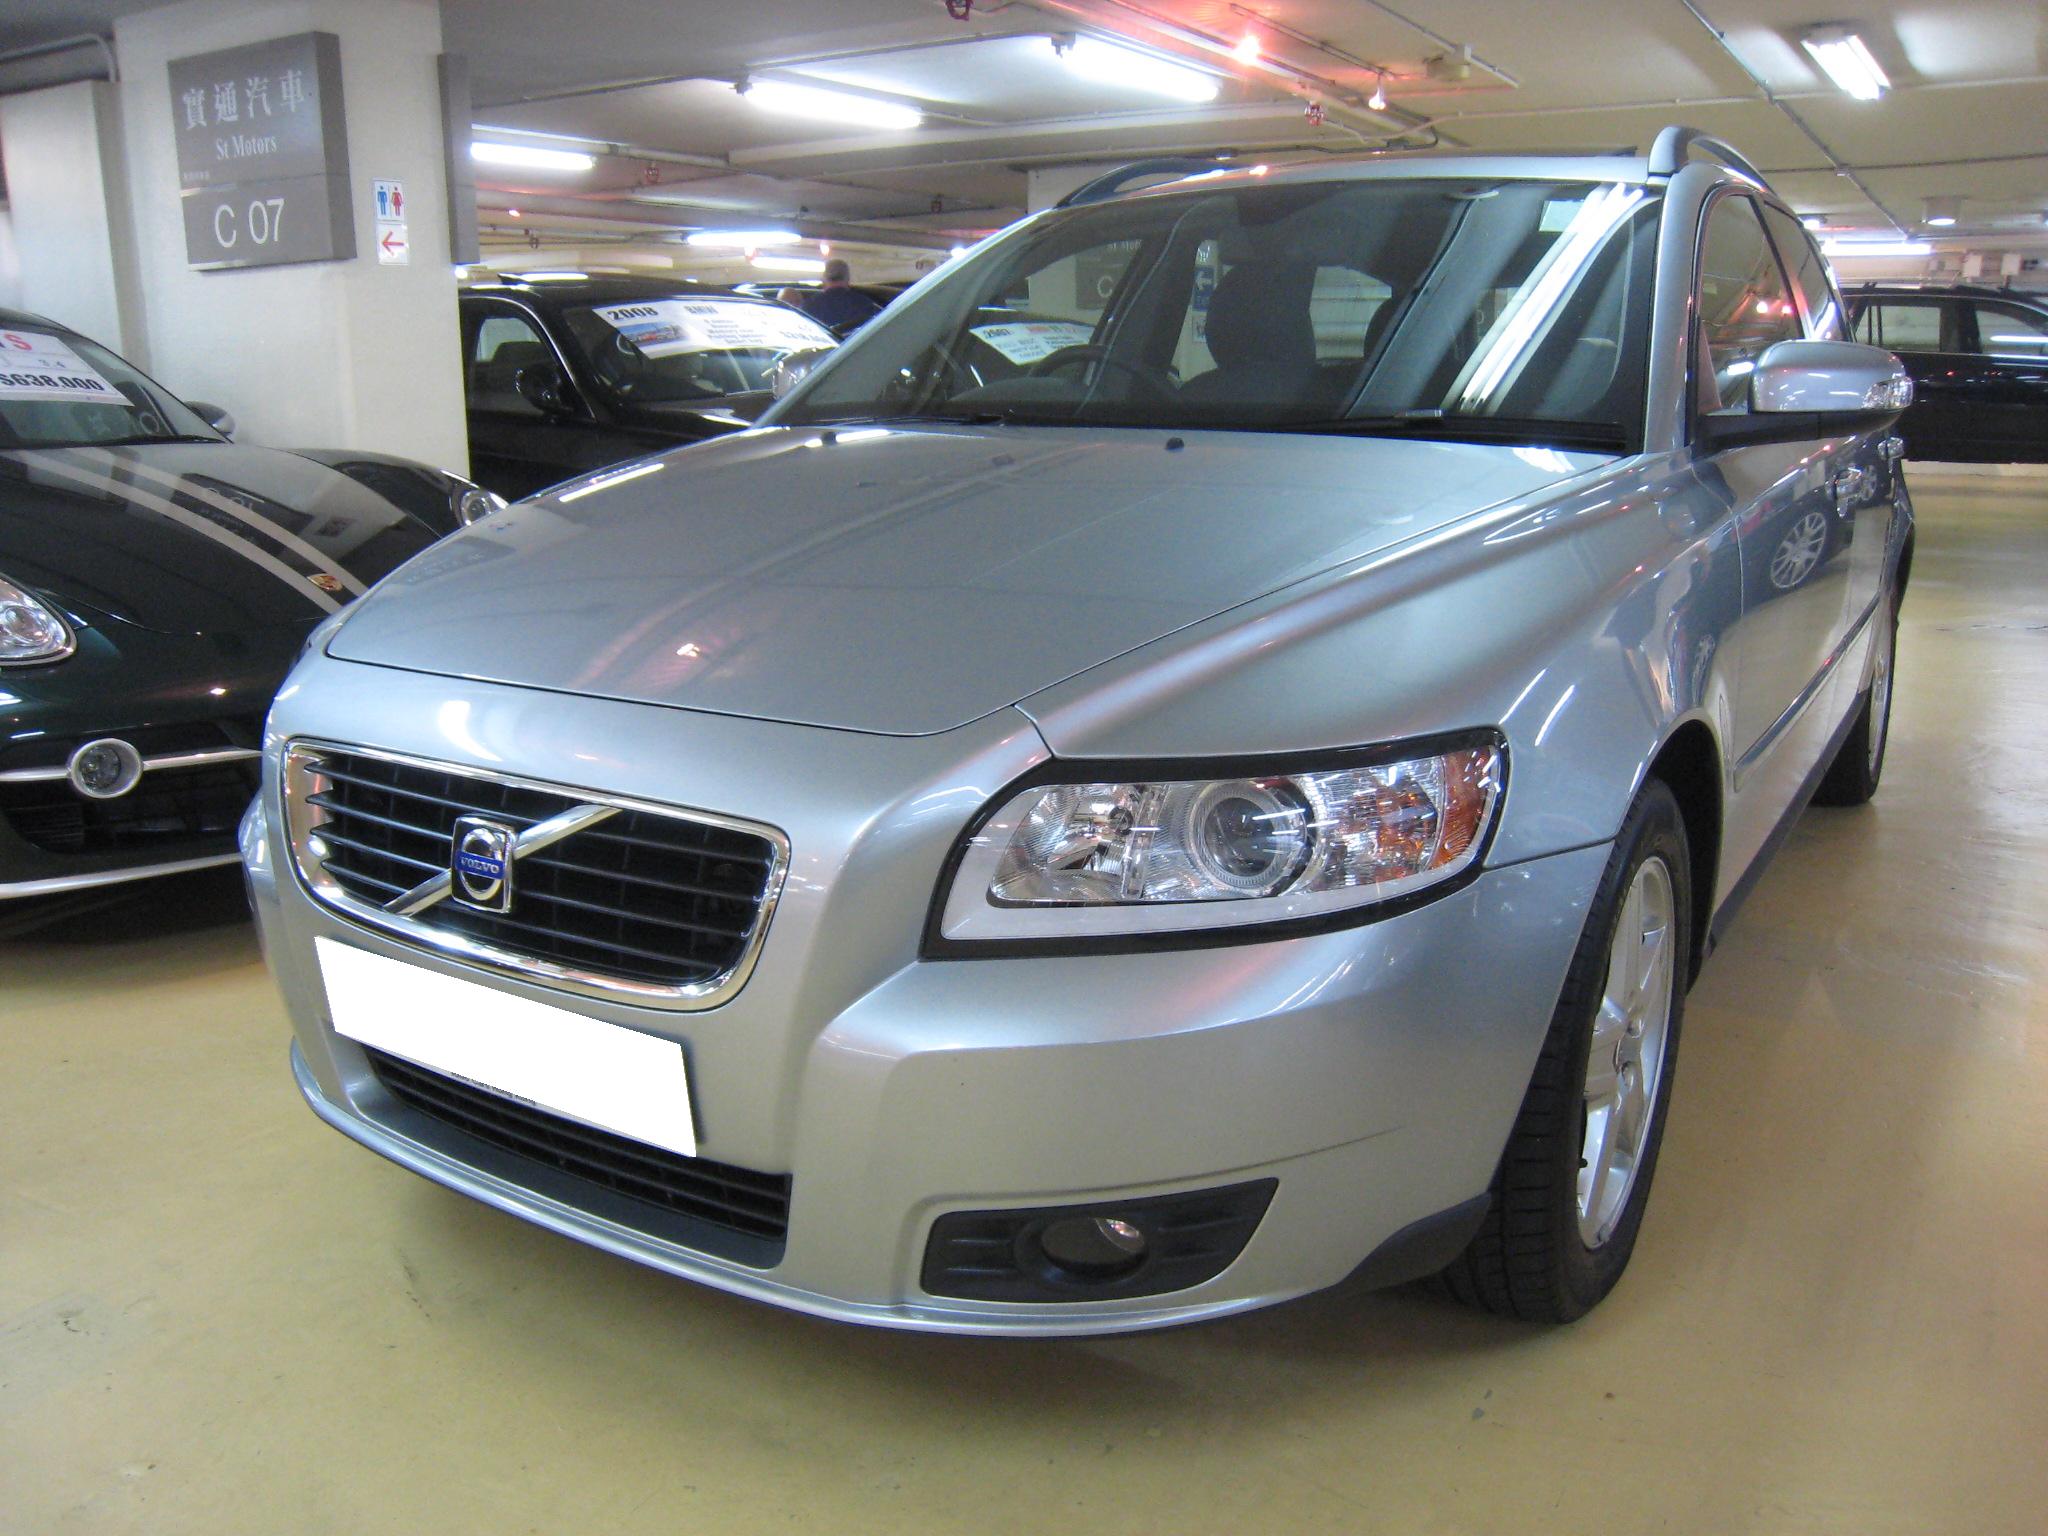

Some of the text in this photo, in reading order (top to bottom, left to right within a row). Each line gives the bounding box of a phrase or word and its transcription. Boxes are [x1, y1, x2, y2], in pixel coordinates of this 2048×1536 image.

[232, 134, 278, 158] Motors
[214, 198, 285, 248] C 07
[606, 306, 660, 321] 2008
[461, 856, 500, 874] VOLVO
